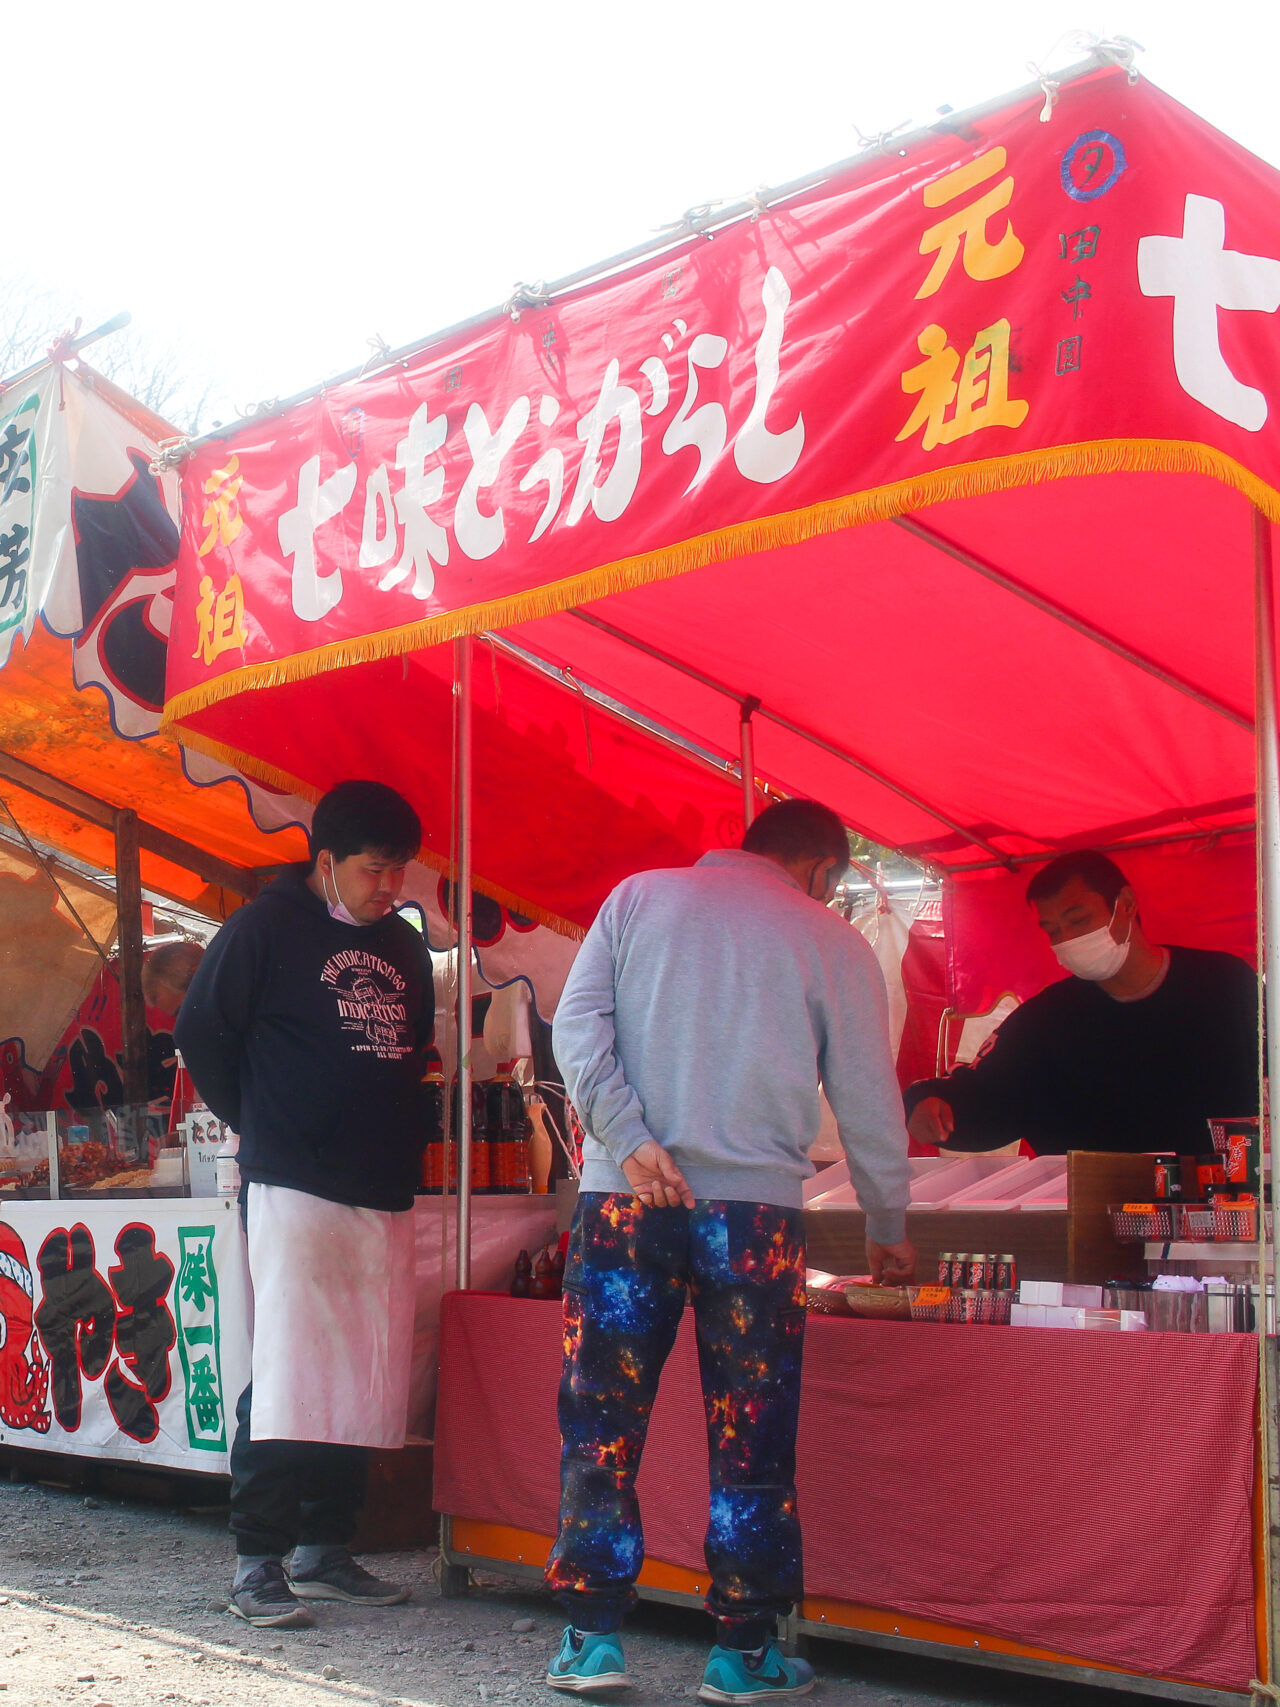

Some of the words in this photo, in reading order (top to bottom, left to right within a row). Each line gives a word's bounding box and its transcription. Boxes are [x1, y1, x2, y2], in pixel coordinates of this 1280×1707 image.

[894, 145, 1030, 451] 元祖
[1137, 192, 1280, 432] 七
[277, 265, 805, 622] 七味とうがらし
[192, 455, 248, 666] 元祖
[320, 960, 341, 985] THE
[337, 998, 408, 1021] INDICATION
[179, 1243, 222, 1433] 味一番
